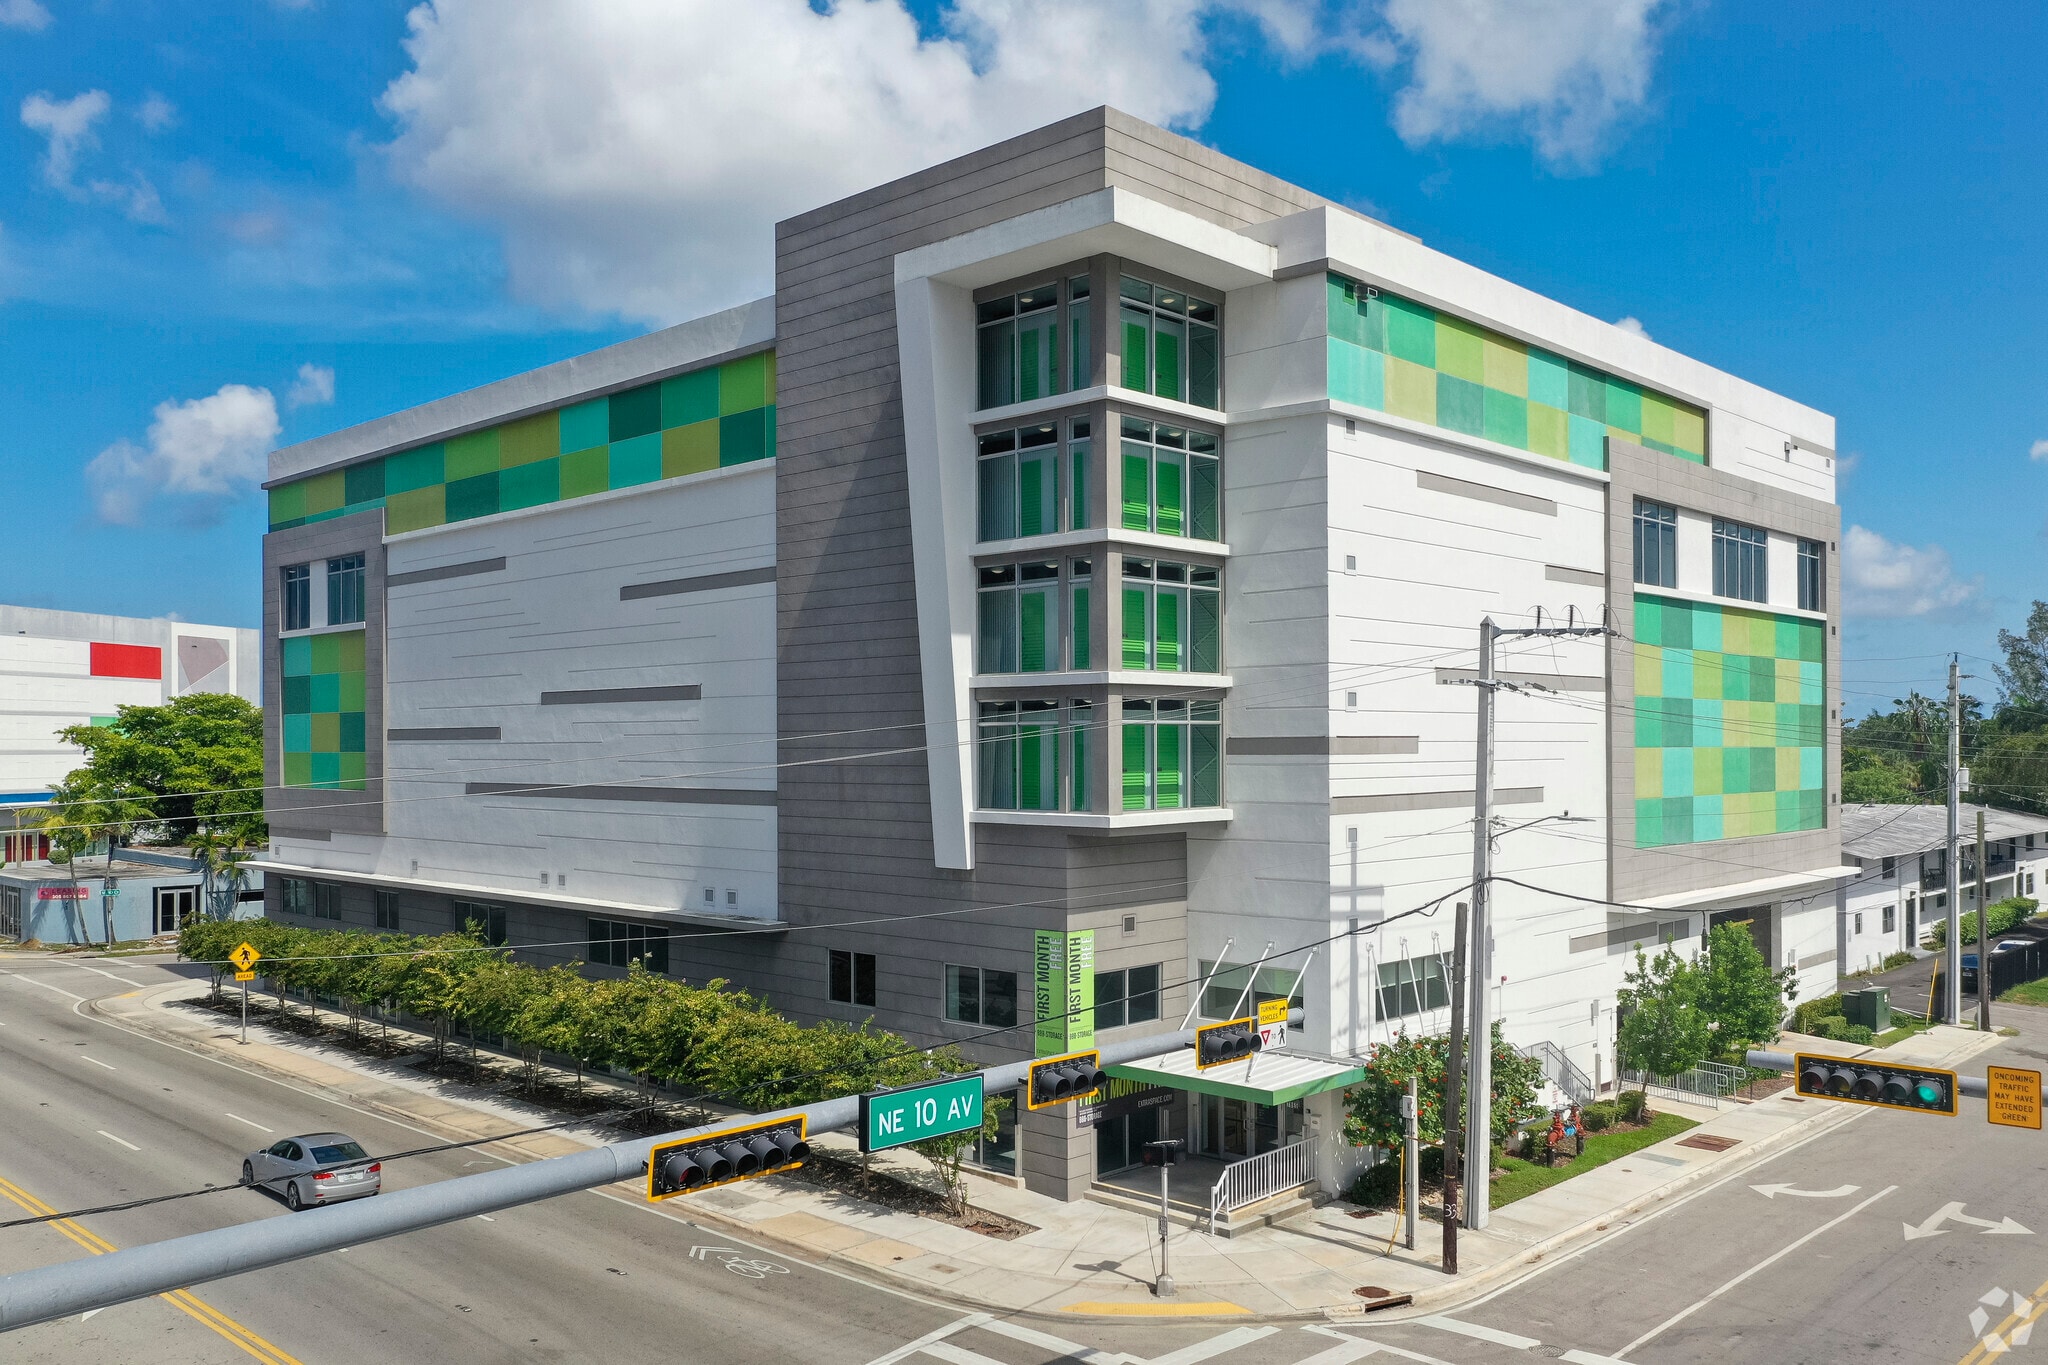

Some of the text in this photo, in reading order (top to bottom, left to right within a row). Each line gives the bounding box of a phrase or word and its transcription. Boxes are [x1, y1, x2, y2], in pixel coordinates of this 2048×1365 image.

[1049, 938, 1062, 970] FREE
[1081, 936, 1092, 969] FREE
[1037, 936, 1050, 1021] FIRST MONTH
[1069, 937, 1081, 1024] FIRST MONTH
[1261, 1004, 1278, 1013] TURNING
[1261, 1013, 1278, 1021] VEHICLES
[1994, 1072, 2034, 1083] ONCOMING
[1999, 1082, 2030, 1092] TRAFFIC
[1994, 1092, 2034, 1103] MAY HAVE
[1995, 1102, 2034, 1113] EXTENDED
[879, 1094, 974, 1137] NE 10 AV
[2001, 1112, 2027, 1122] GREEN
[1445, 1203, 1457, 1219] 33
